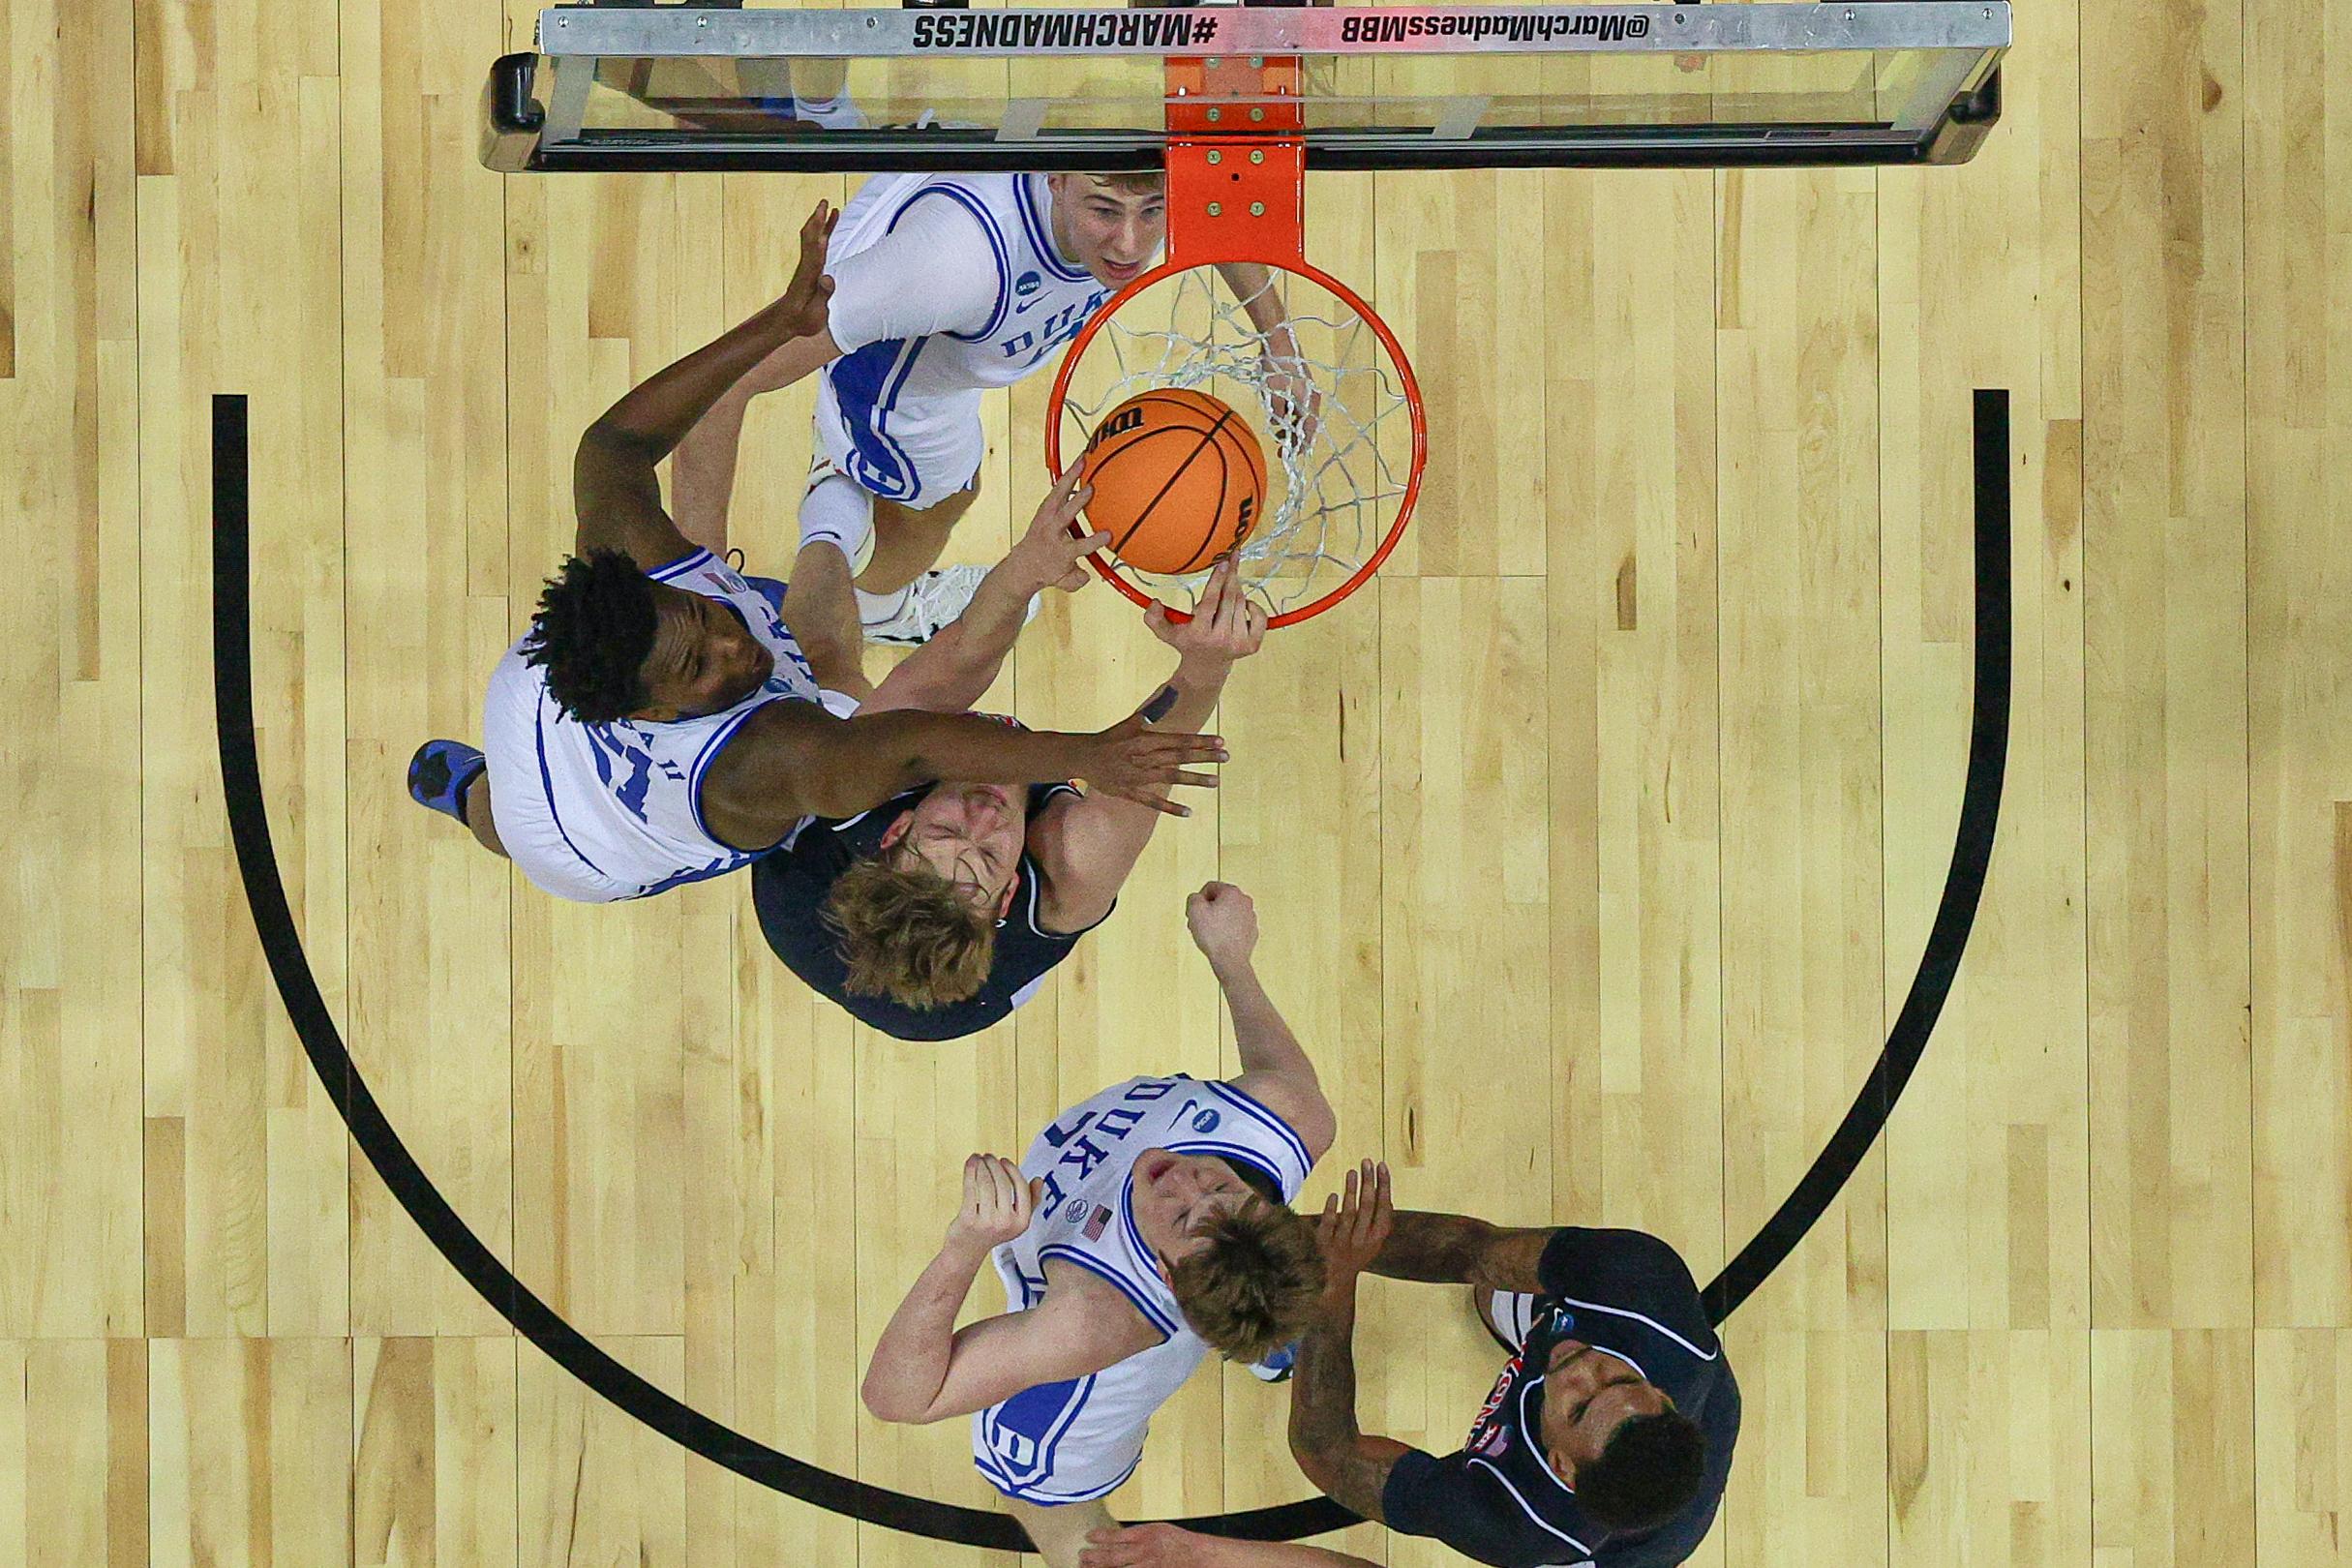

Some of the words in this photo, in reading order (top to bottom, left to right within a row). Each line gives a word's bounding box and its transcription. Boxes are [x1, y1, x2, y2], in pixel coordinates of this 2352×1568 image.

[913, 14, 1219, 48] #MARCHMADNESS
[1341, 15, 1650, 43] @MarchMadnessMBB
[1001, 289, 1111, 358] DUK
